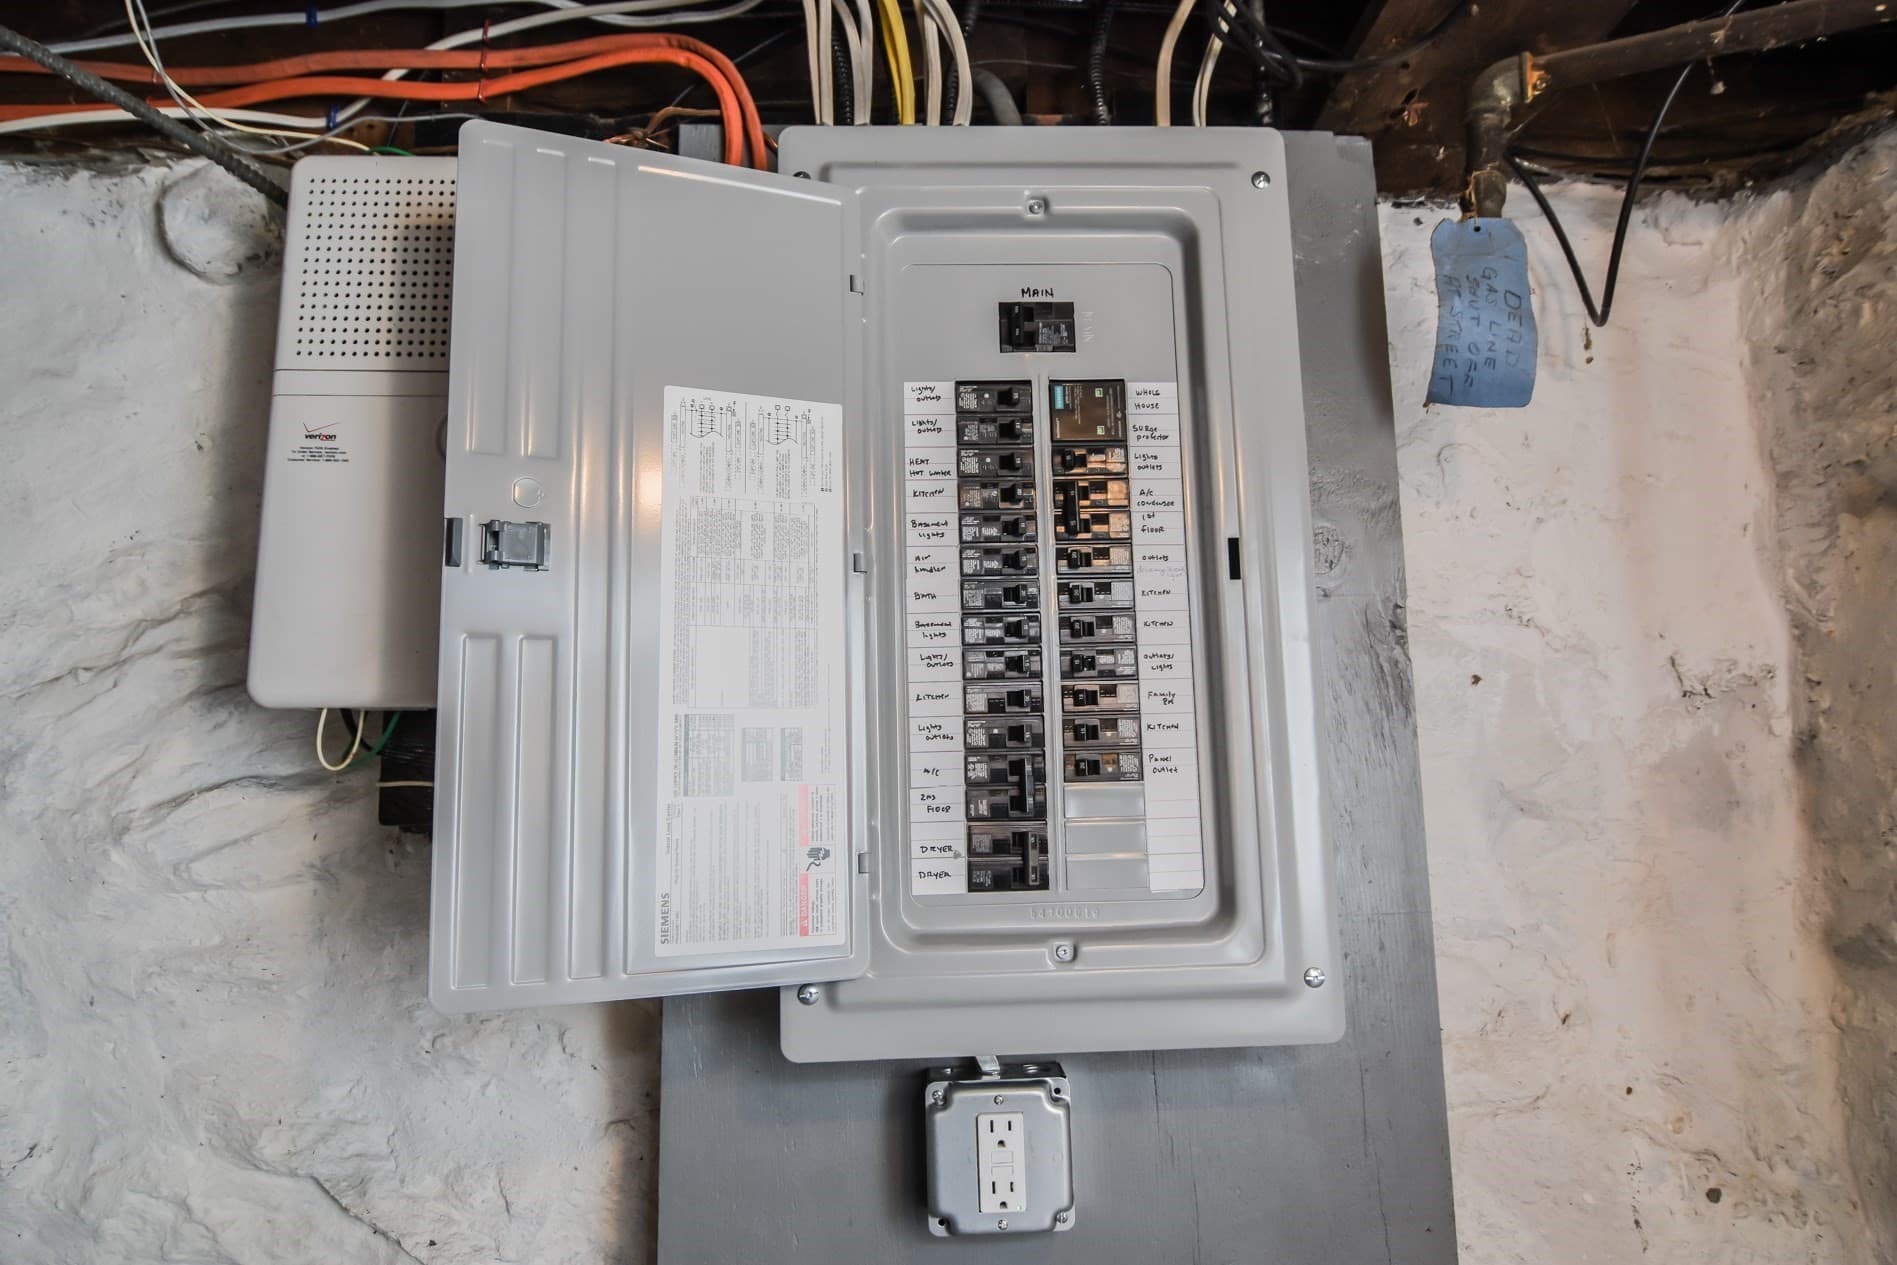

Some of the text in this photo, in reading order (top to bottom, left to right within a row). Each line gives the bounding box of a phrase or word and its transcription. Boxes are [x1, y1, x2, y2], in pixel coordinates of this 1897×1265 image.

[1020, 287, 1055, 299] MAIN
[1481, 266, 1502, 371] GAS LINE
[1439, 273, 1463, 396] AT STREET
[1464, 273, 1482, 388] SHUT OFF
[1504, 289, 1523, 368] DEAD
[304, 433, 336, 441] verizon
[918, 871, 952, 879] DRYER
[920, 845, 953, 854] DRYER
[660, 892, 670, 945] SIEMENS
